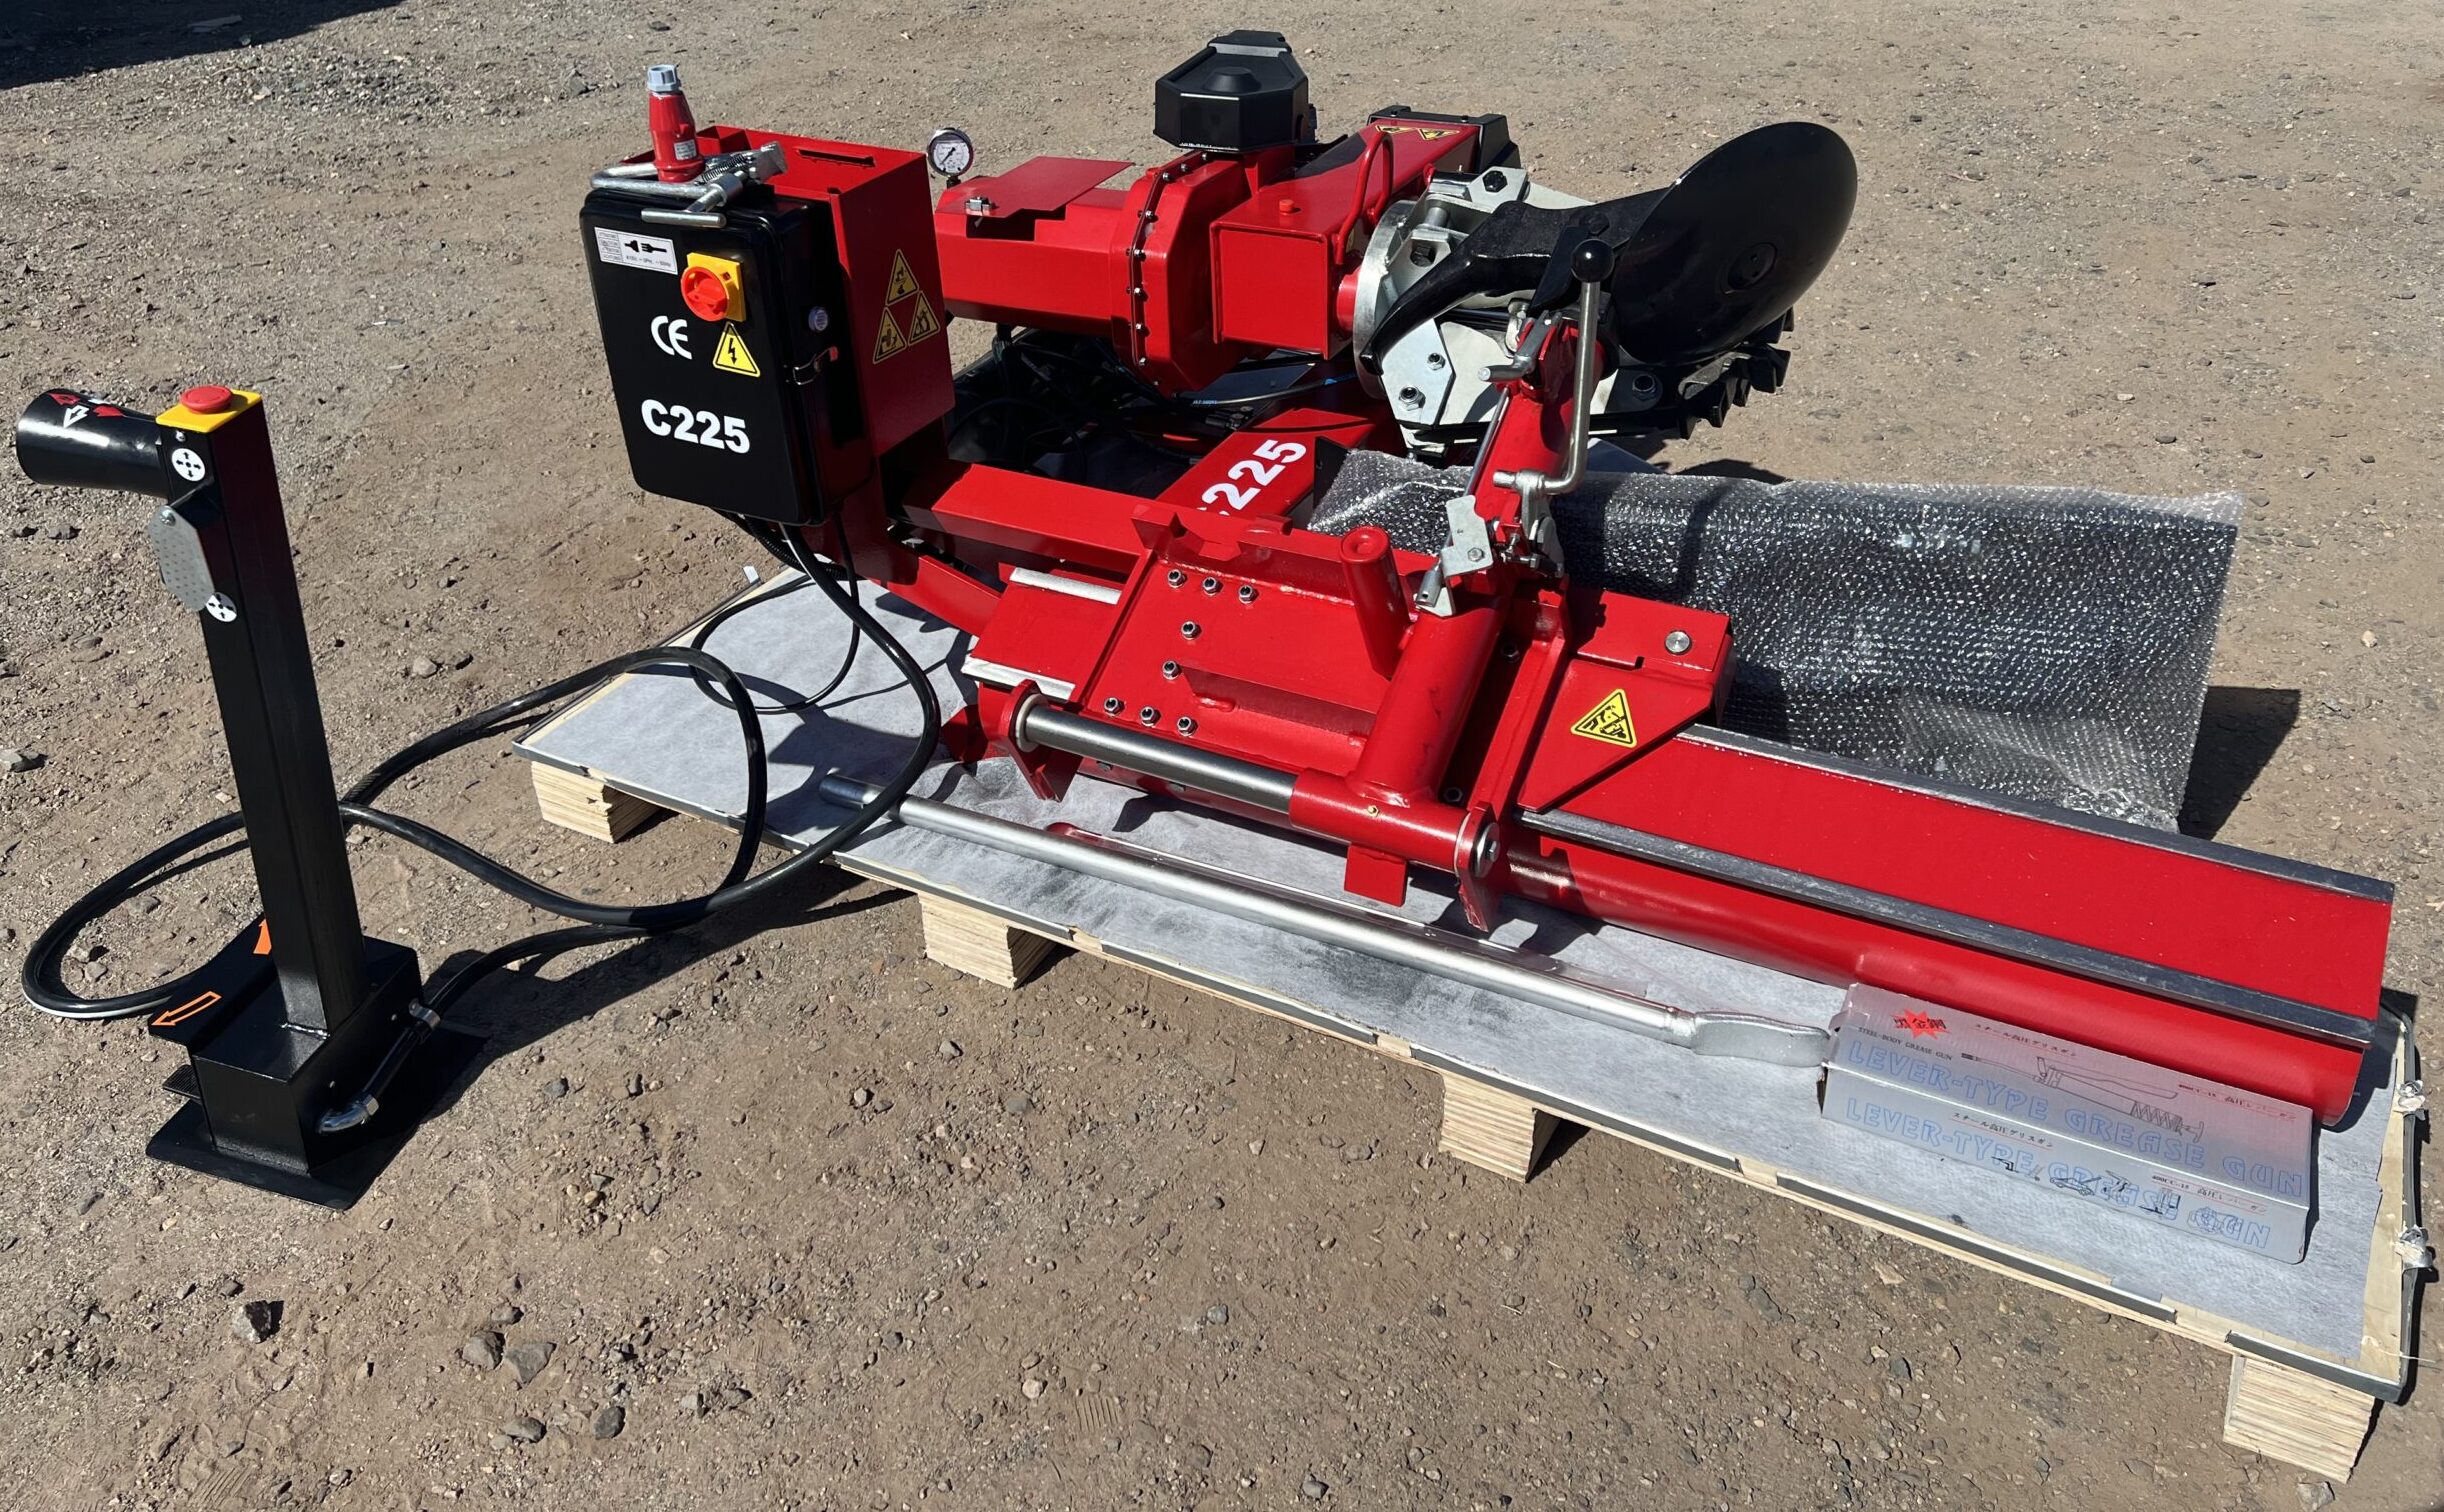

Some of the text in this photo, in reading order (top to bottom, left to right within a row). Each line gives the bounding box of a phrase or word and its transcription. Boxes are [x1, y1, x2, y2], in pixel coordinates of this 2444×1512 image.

[651, 315, 693, 360] CE
[641, 399, 750, 454] C225
[1197, 439, 1306, 515] 225
[1858, 1027, 1953, 1061] STEEL-BODY GREASE GUN
[1847, 1039, 2303, 1198] LEVER-TYPE GREASE GUN
[1846, 1098, 2271, 1249] LEVER-TYPE GREASE GUN
